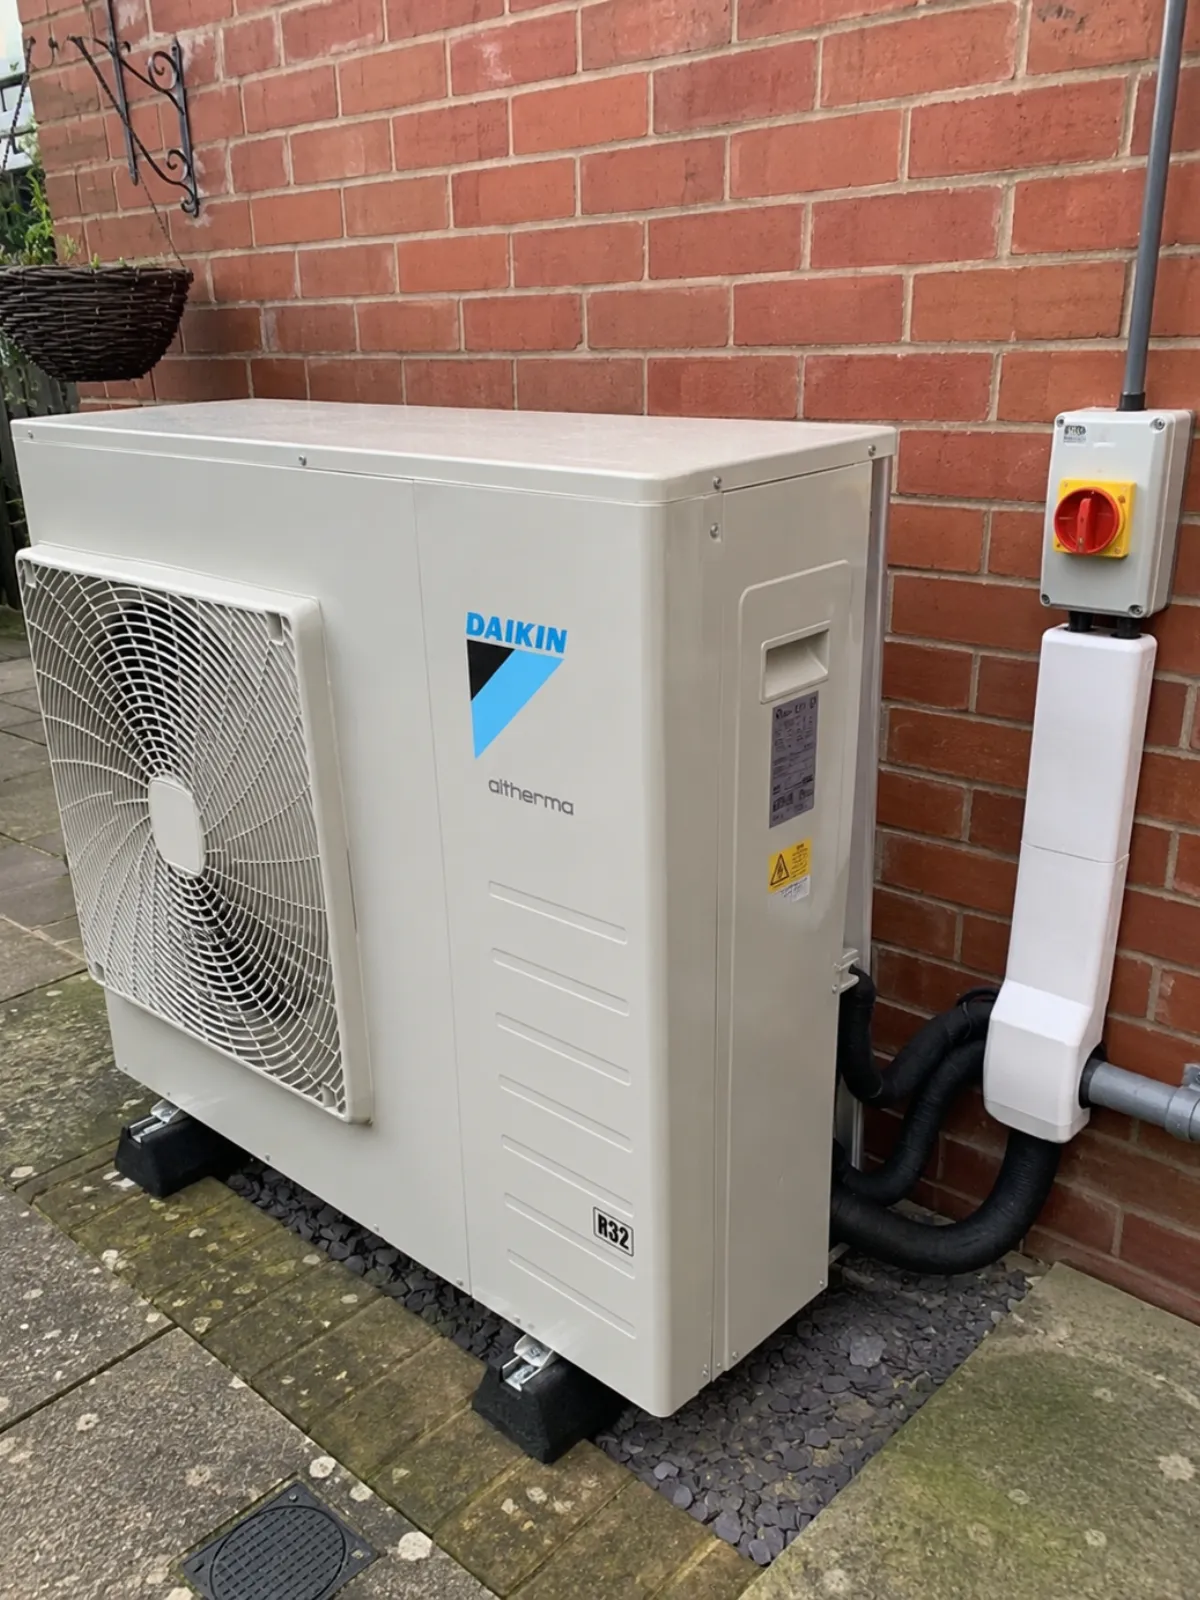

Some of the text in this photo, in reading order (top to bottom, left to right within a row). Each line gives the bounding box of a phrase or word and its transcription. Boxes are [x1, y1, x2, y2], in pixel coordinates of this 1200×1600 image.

[466, 612, 567, 654] DAIKIN
[488, 778, 574, 816] altherma
[598, 1213, 629, 1250] R32
